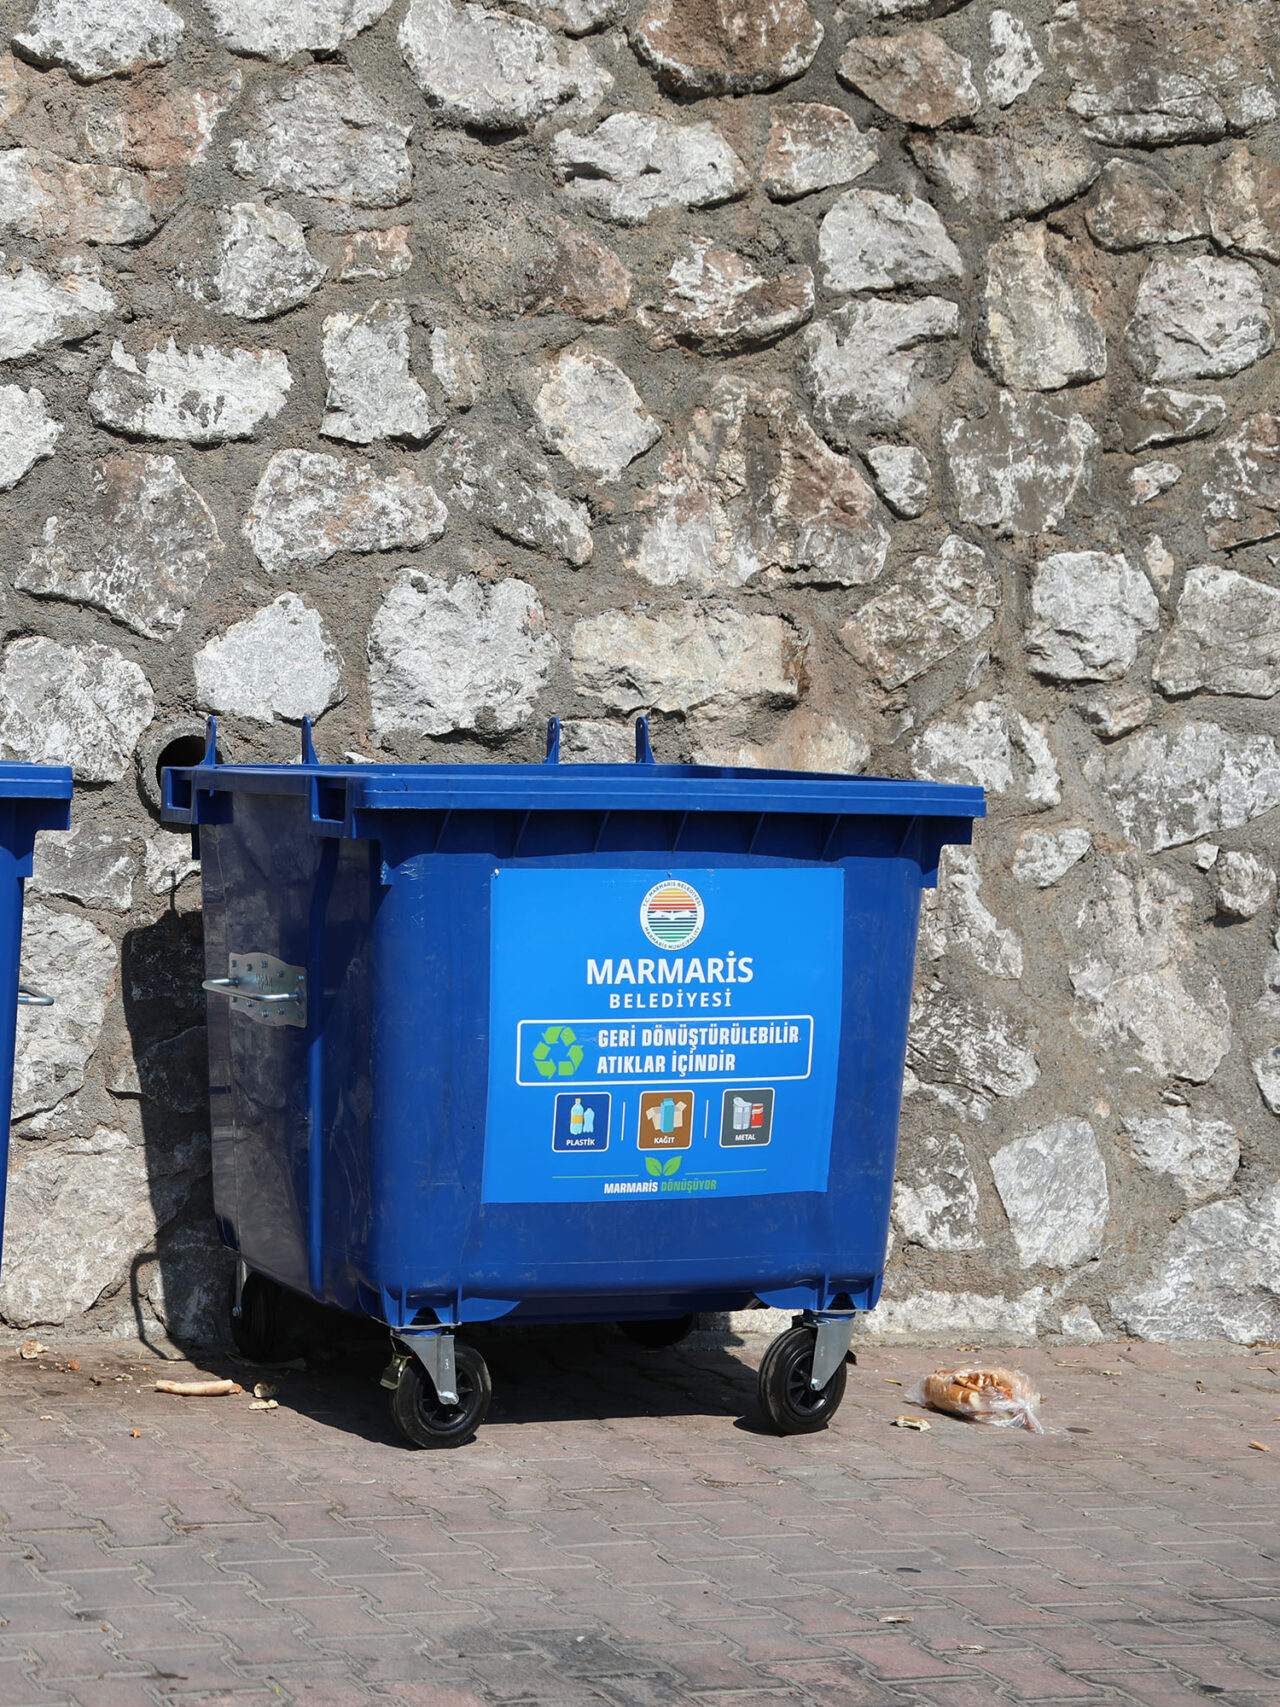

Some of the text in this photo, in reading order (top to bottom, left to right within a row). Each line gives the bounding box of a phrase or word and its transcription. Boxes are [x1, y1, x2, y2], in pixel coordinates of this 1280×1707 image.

[586, 951, 754, 985] MARMARİS
[609, 988, 732, 1009] BELEDİYESİ
[598, 1022, 800, 1050] GERİ DÖNÜŞTÜRÜLEBİLİR
[596, 1049, 736, 1077] ATIKLAR İÇİNDİR
[565, 1137, 596, 1147] PLASTİK
[653, 1135, 676, 1145] KAĞIT
[734, 1133, 757, 1142] METAL
[603, 1178, 718, 1195] MARMARİS DÖNÜŞÜYOR
